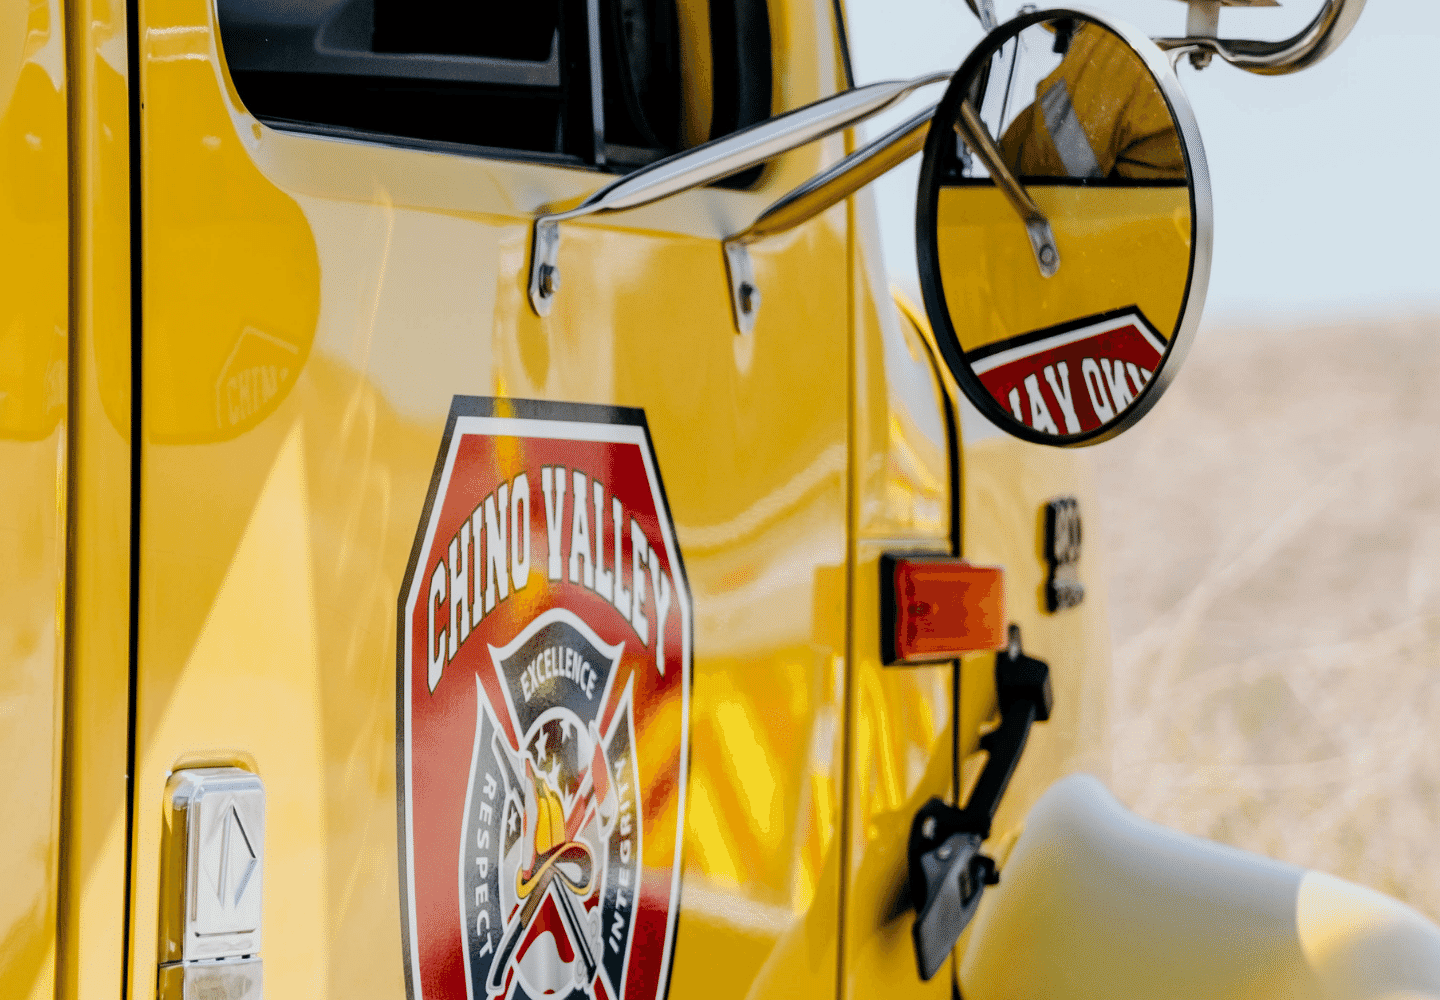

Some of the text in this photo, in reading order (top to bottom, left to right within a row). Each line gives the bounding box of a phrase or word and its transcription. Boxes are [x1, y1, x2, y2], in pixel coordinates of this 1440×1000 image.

[427, 465, 672, 695] CHINO VALLEY
[520, 645, 598, 703] EXCELLENCE
[475, 772, 498, 958] RESPECT
[609, 758, 629, 955] INTEGRITY
